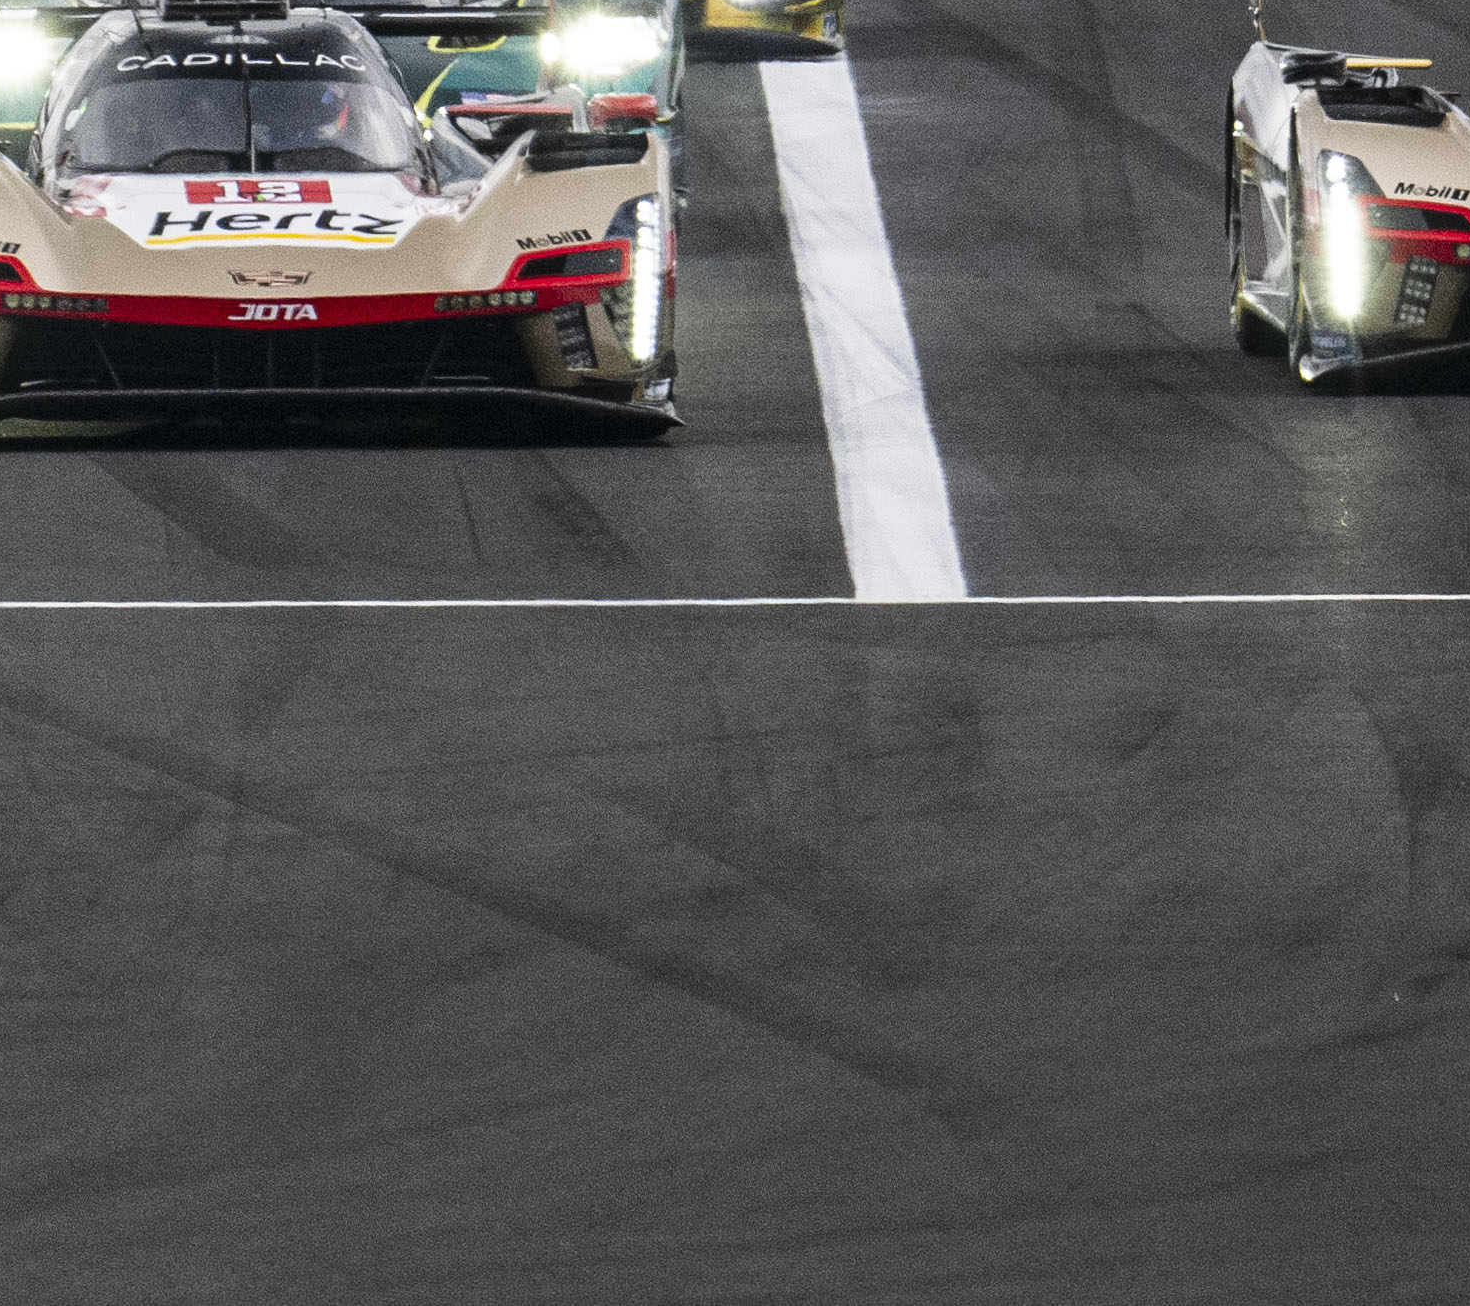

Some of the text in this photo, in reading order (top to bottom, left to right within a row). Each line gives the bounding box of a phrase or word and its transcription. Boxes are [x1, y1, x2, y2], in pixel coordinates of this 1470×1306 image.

[116, 52, 367, 73] CADILLAC
[213, 180, 302, 204] 12
[1393, 182, 1452, 200] Mobil
[147, 208, 406, 237] Hertz
[515, 230, 573, 251] Mobil
[227, 302, 319, 321] JOTA
